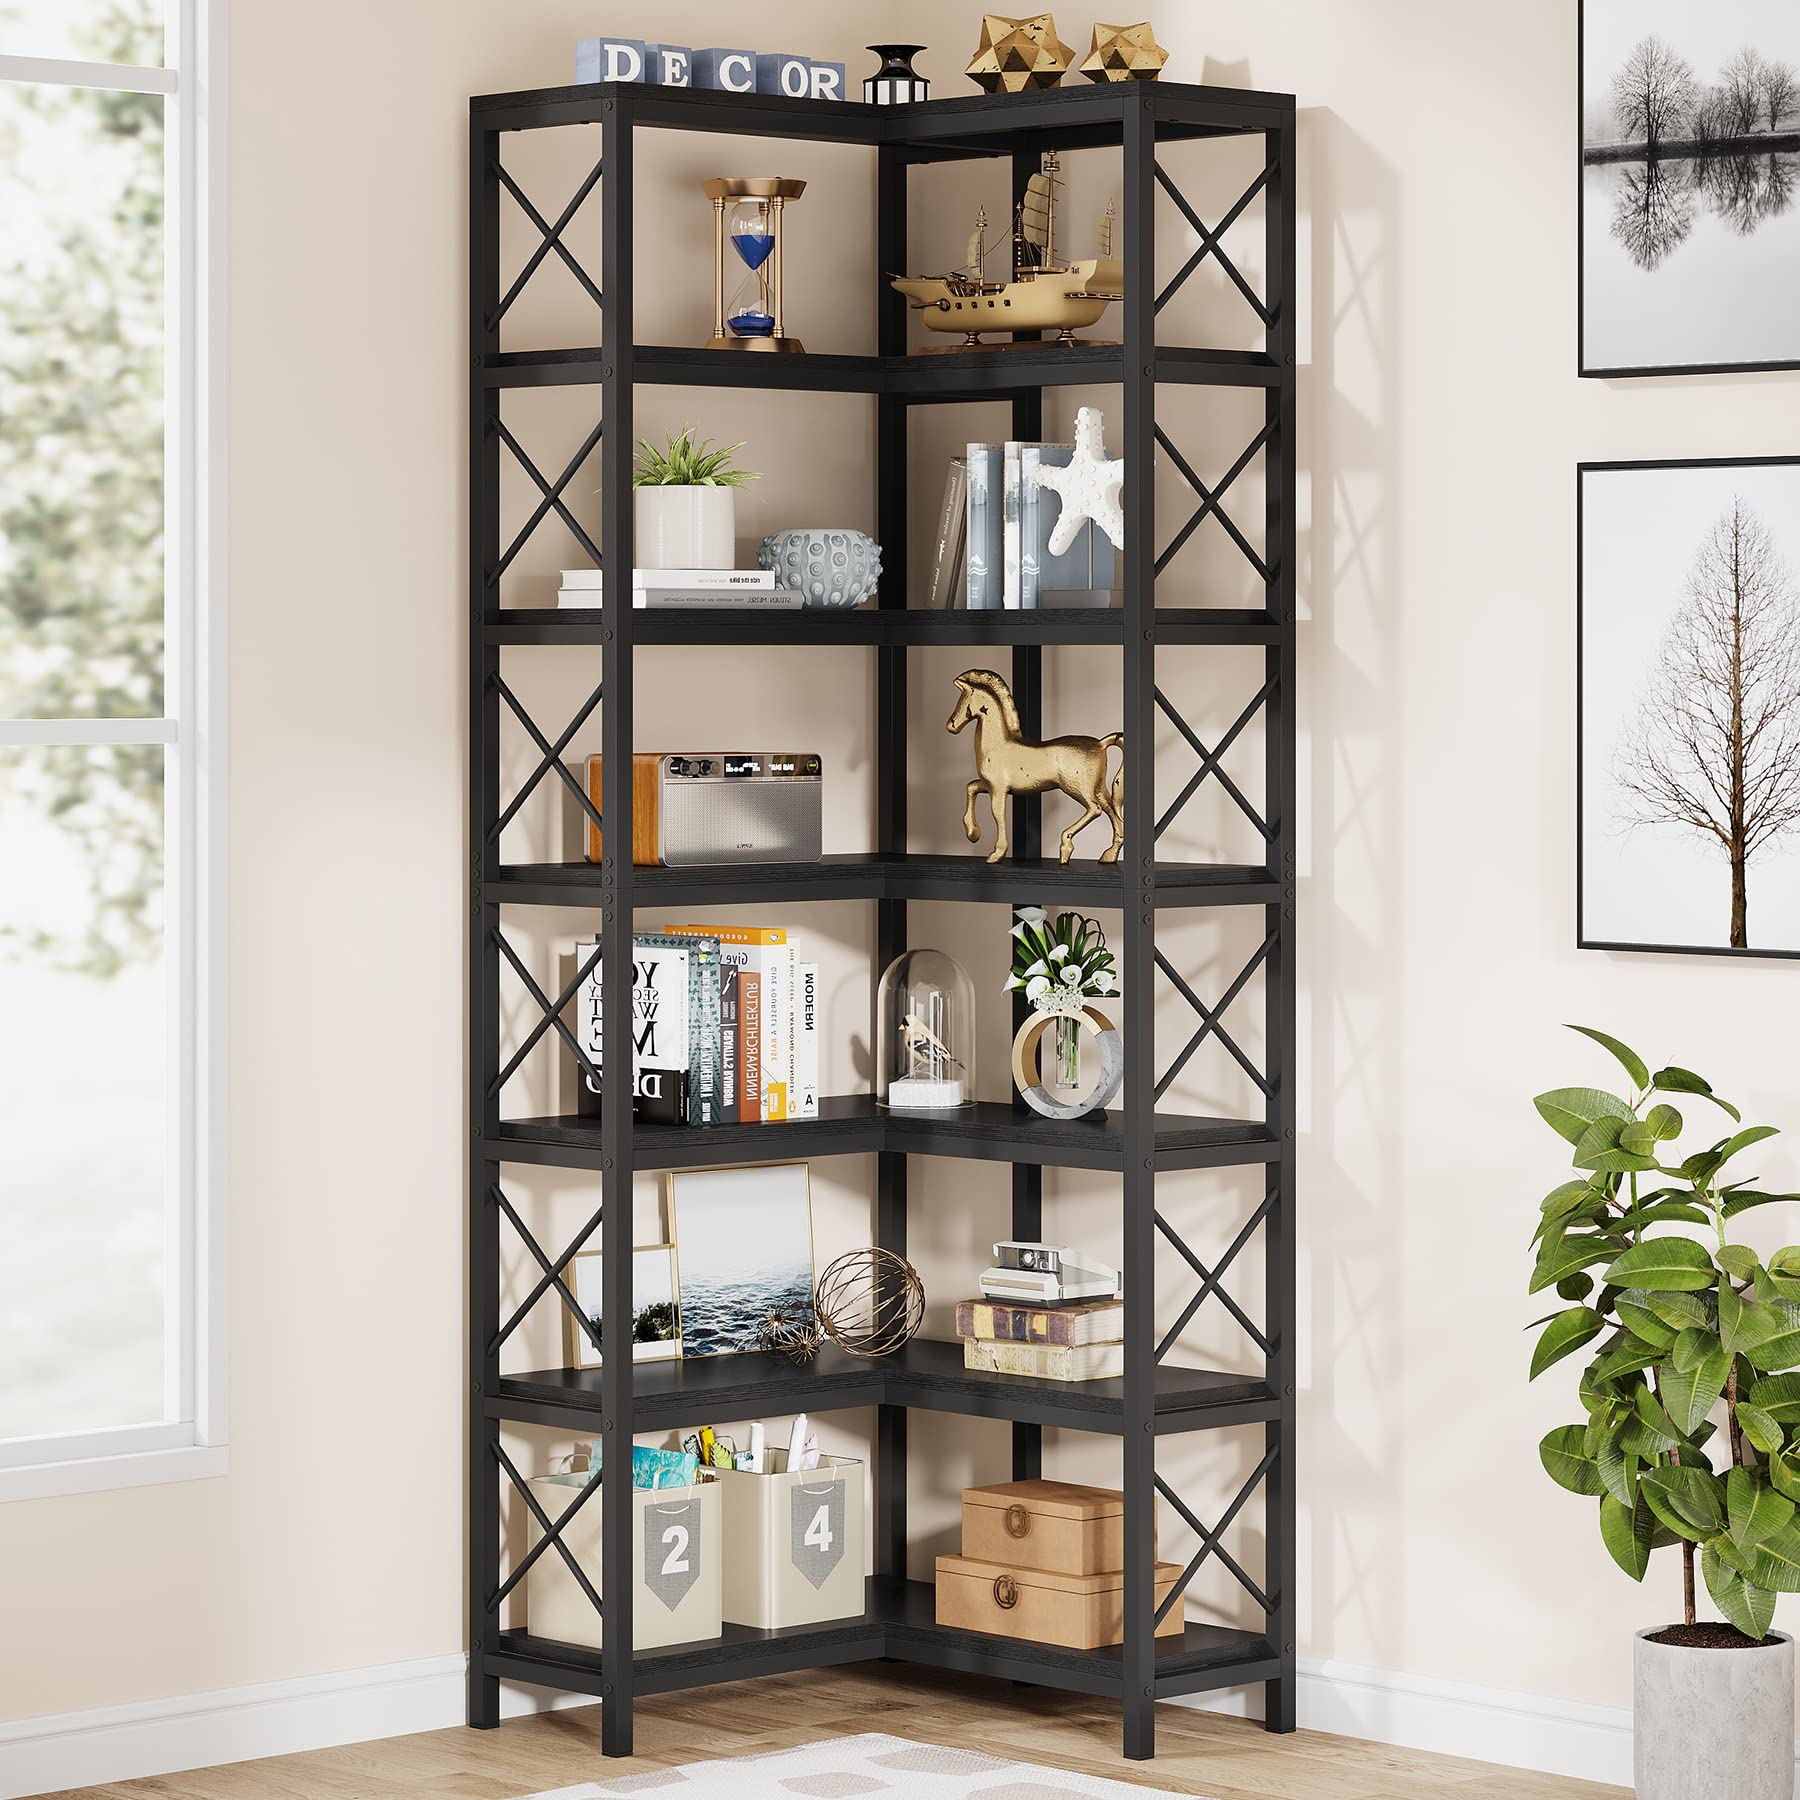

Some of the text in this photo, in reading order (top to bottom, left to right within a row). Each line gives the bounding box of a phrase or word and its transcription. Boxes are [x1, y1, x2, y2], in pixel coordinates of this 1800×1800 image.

[603, 43, 842, 102] DECOR
[661, 1525, 690, 1575] 2
[804, 1504, 833, 1552] 4
